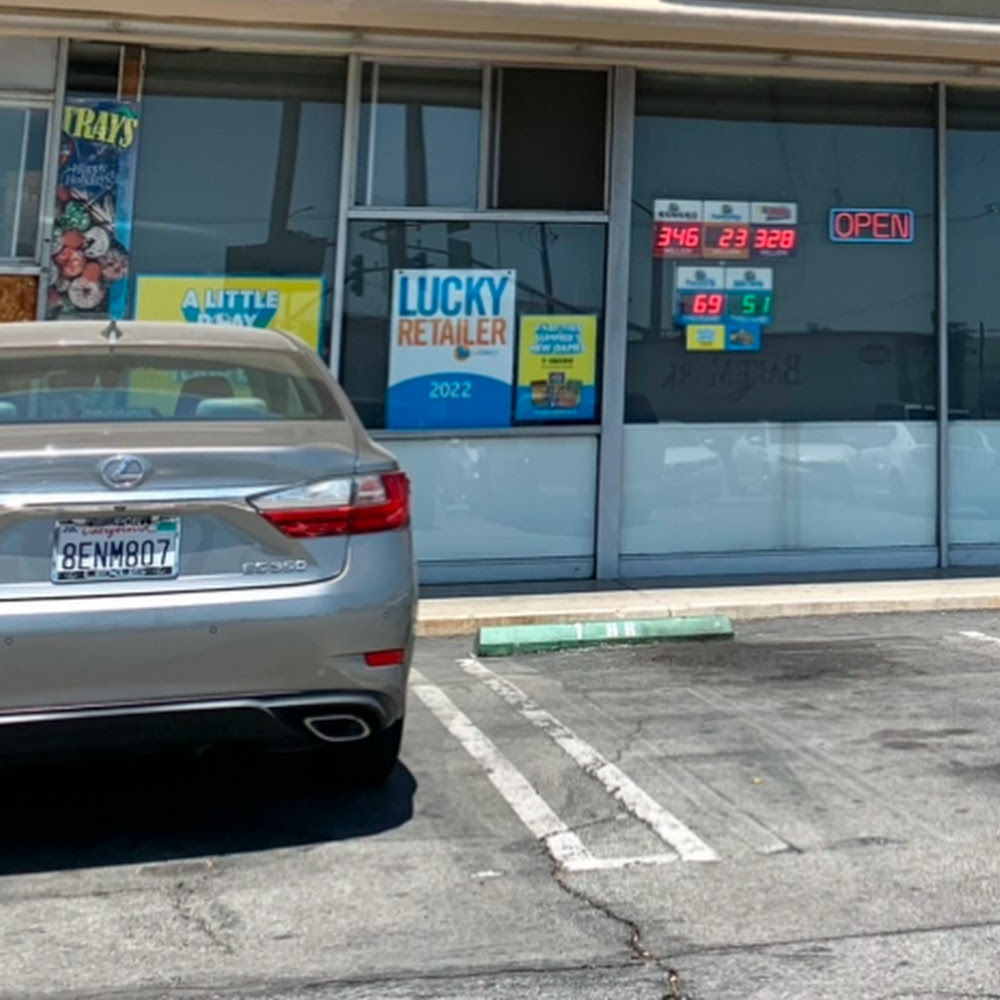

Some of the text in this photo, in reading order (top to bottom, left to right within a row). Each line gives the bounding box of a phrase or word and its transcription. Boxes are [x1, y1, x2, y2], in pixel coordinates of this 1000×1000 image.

[657, 226, 699, 247] 346
[834, 212, 909, 239] OPEN
[718, 227, 748, 248] 23
[753, 228, 796, 249] 328
[182, 289, 280, 310] A LITTLE
[398, 275, 509, 318] LUCKY
[693, 293, 723, 315] 69
[741, 293, 771, 315] 51
[397, 317, 508, 347] RETAILER
[428, 381, 472, 398] 2022
[61, 539, 171, 570] 8ENM807
